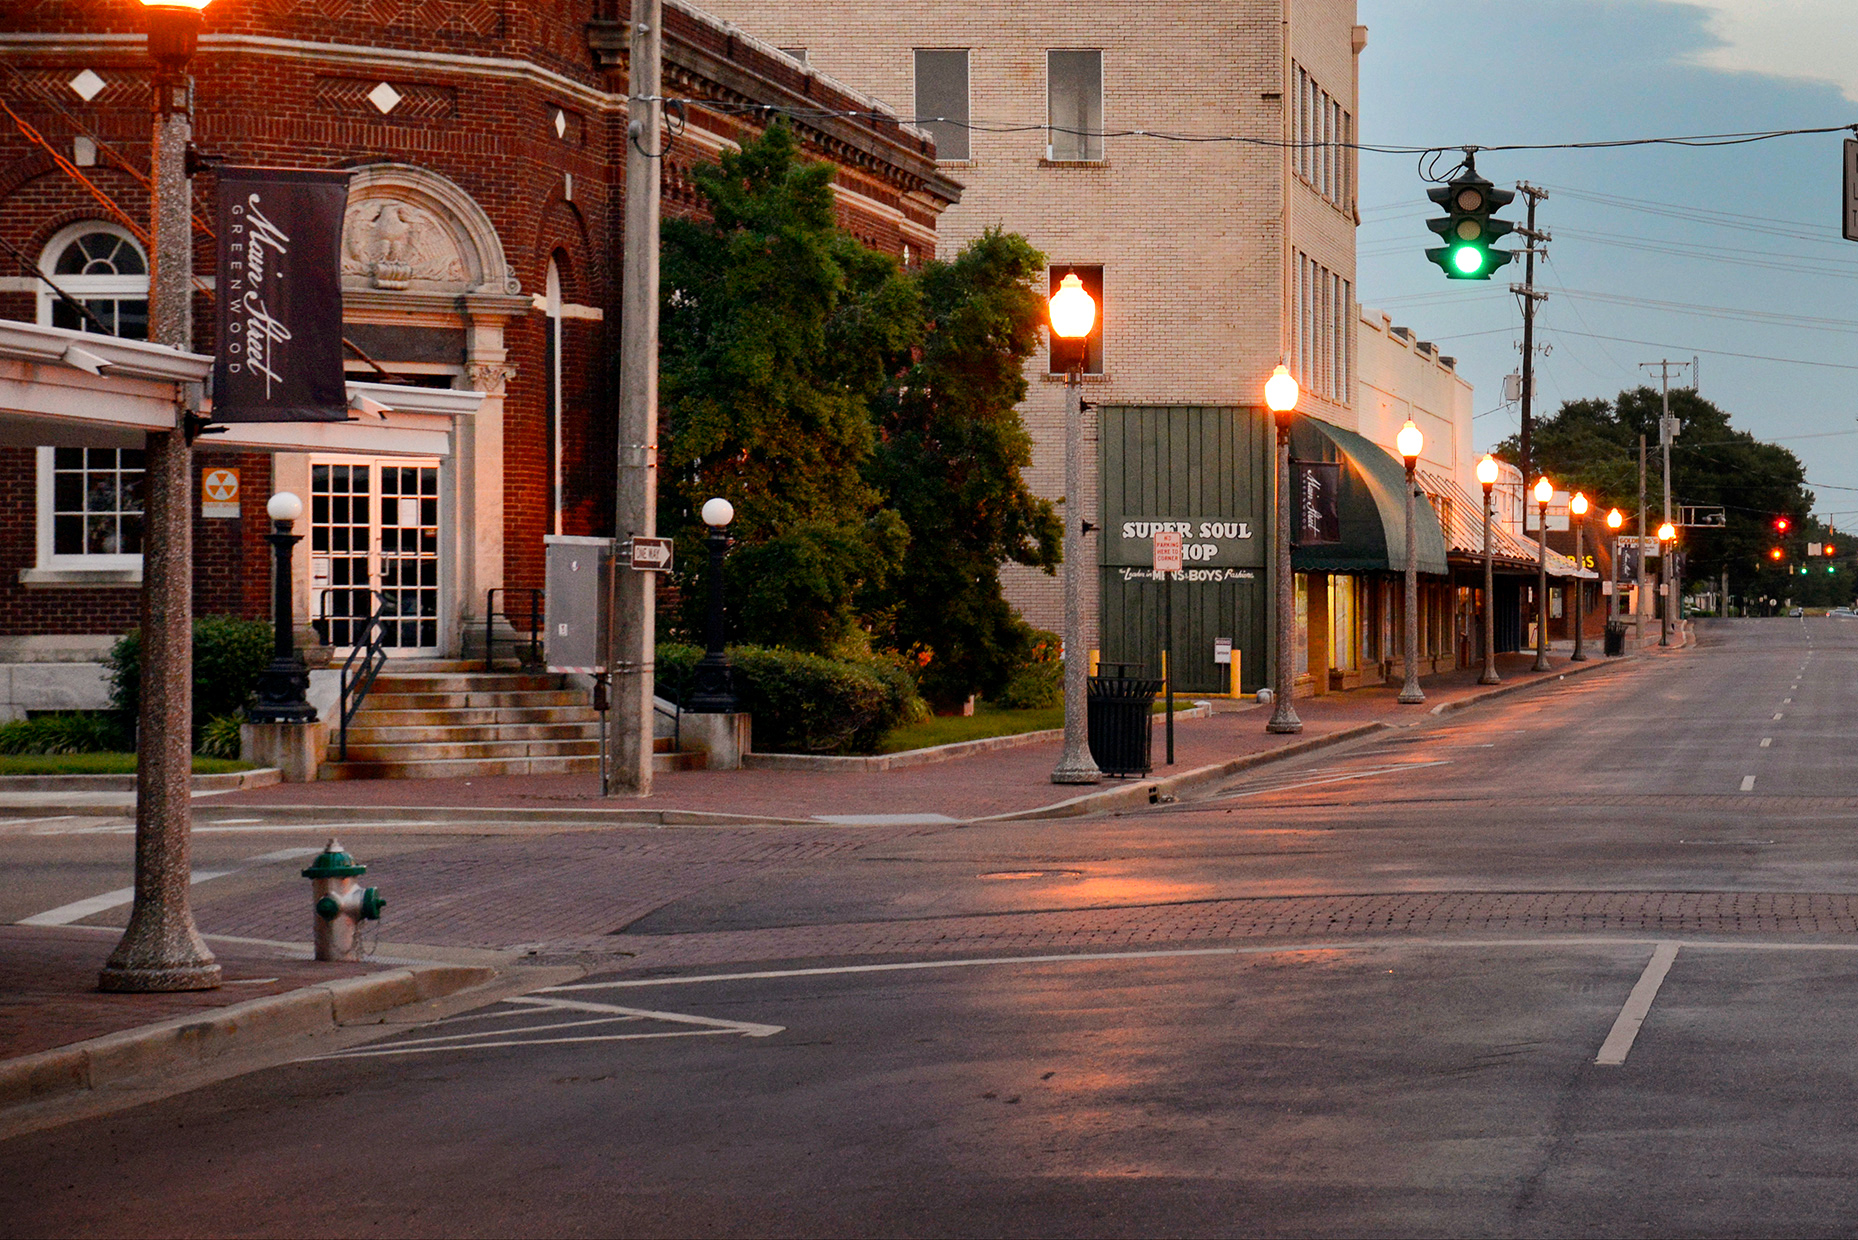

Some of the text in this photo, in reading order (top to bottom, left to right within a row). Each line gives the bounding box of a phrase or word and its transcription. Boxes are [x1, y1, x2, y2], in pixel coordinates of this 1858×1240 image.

[229, 204, 244, 374] GREENWOOD
[243, 193, 293, 401] Main Street
[1306, 469, 1323, 538] Main Street
[1122, 521, 1253, 539] SUPER SOUL
[636, 547, 661, 560] ONE WAY
[1180, 543, 1218, 561] HOP
[1189, 569, 1223, 581] BOYS
